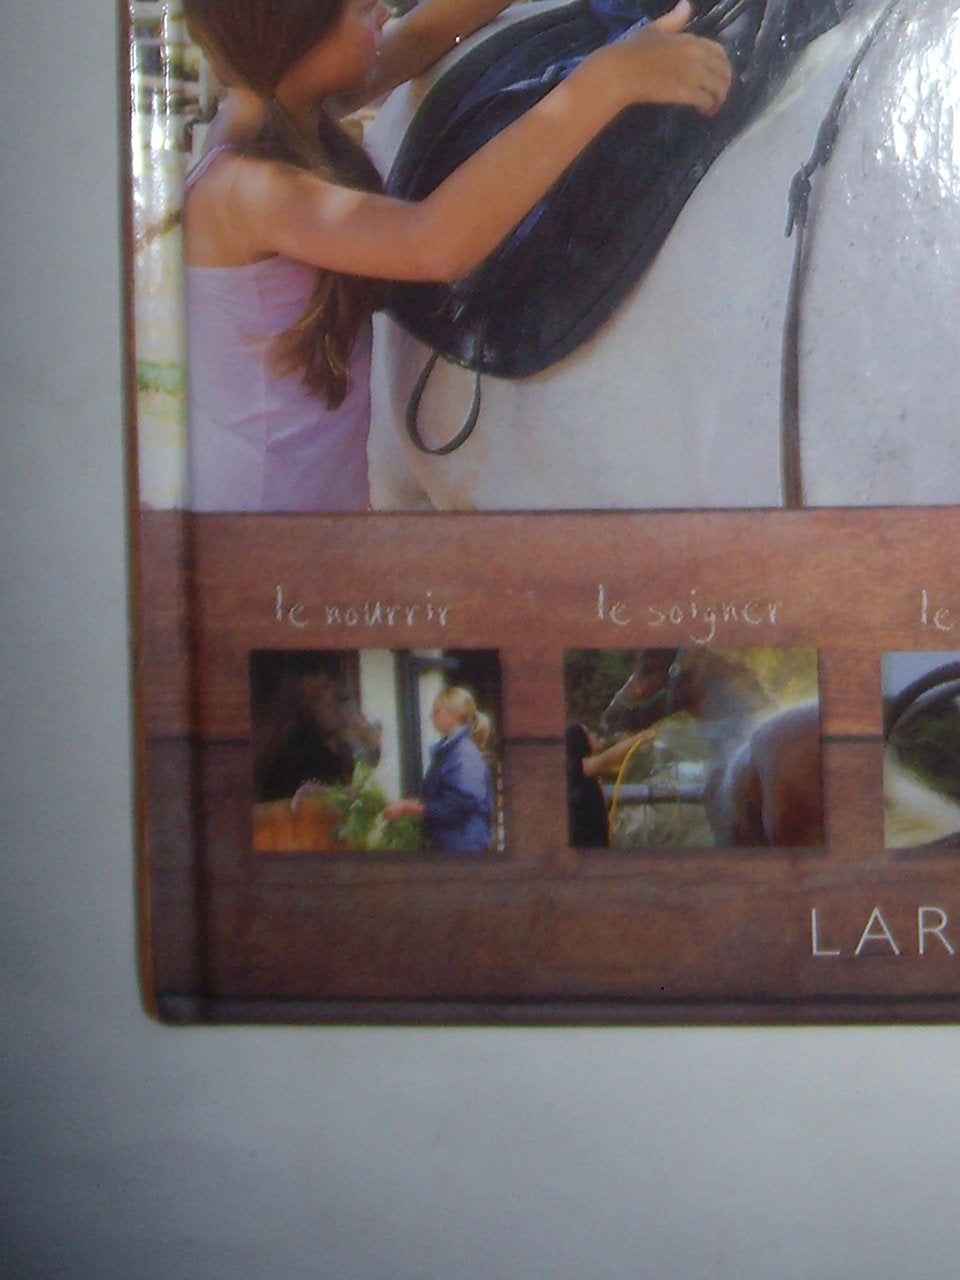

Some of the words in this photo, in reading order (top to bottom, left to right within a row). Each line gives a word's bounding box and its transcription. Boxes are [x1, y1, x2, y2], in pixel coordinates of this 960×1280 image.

[275, 585, 310, 627] le
[325, 591, 452, 626] nourrir
[598, 584, 631, 626] le
[647, 589, 784, 643] soigner
[920, 589, 954, 631] le
